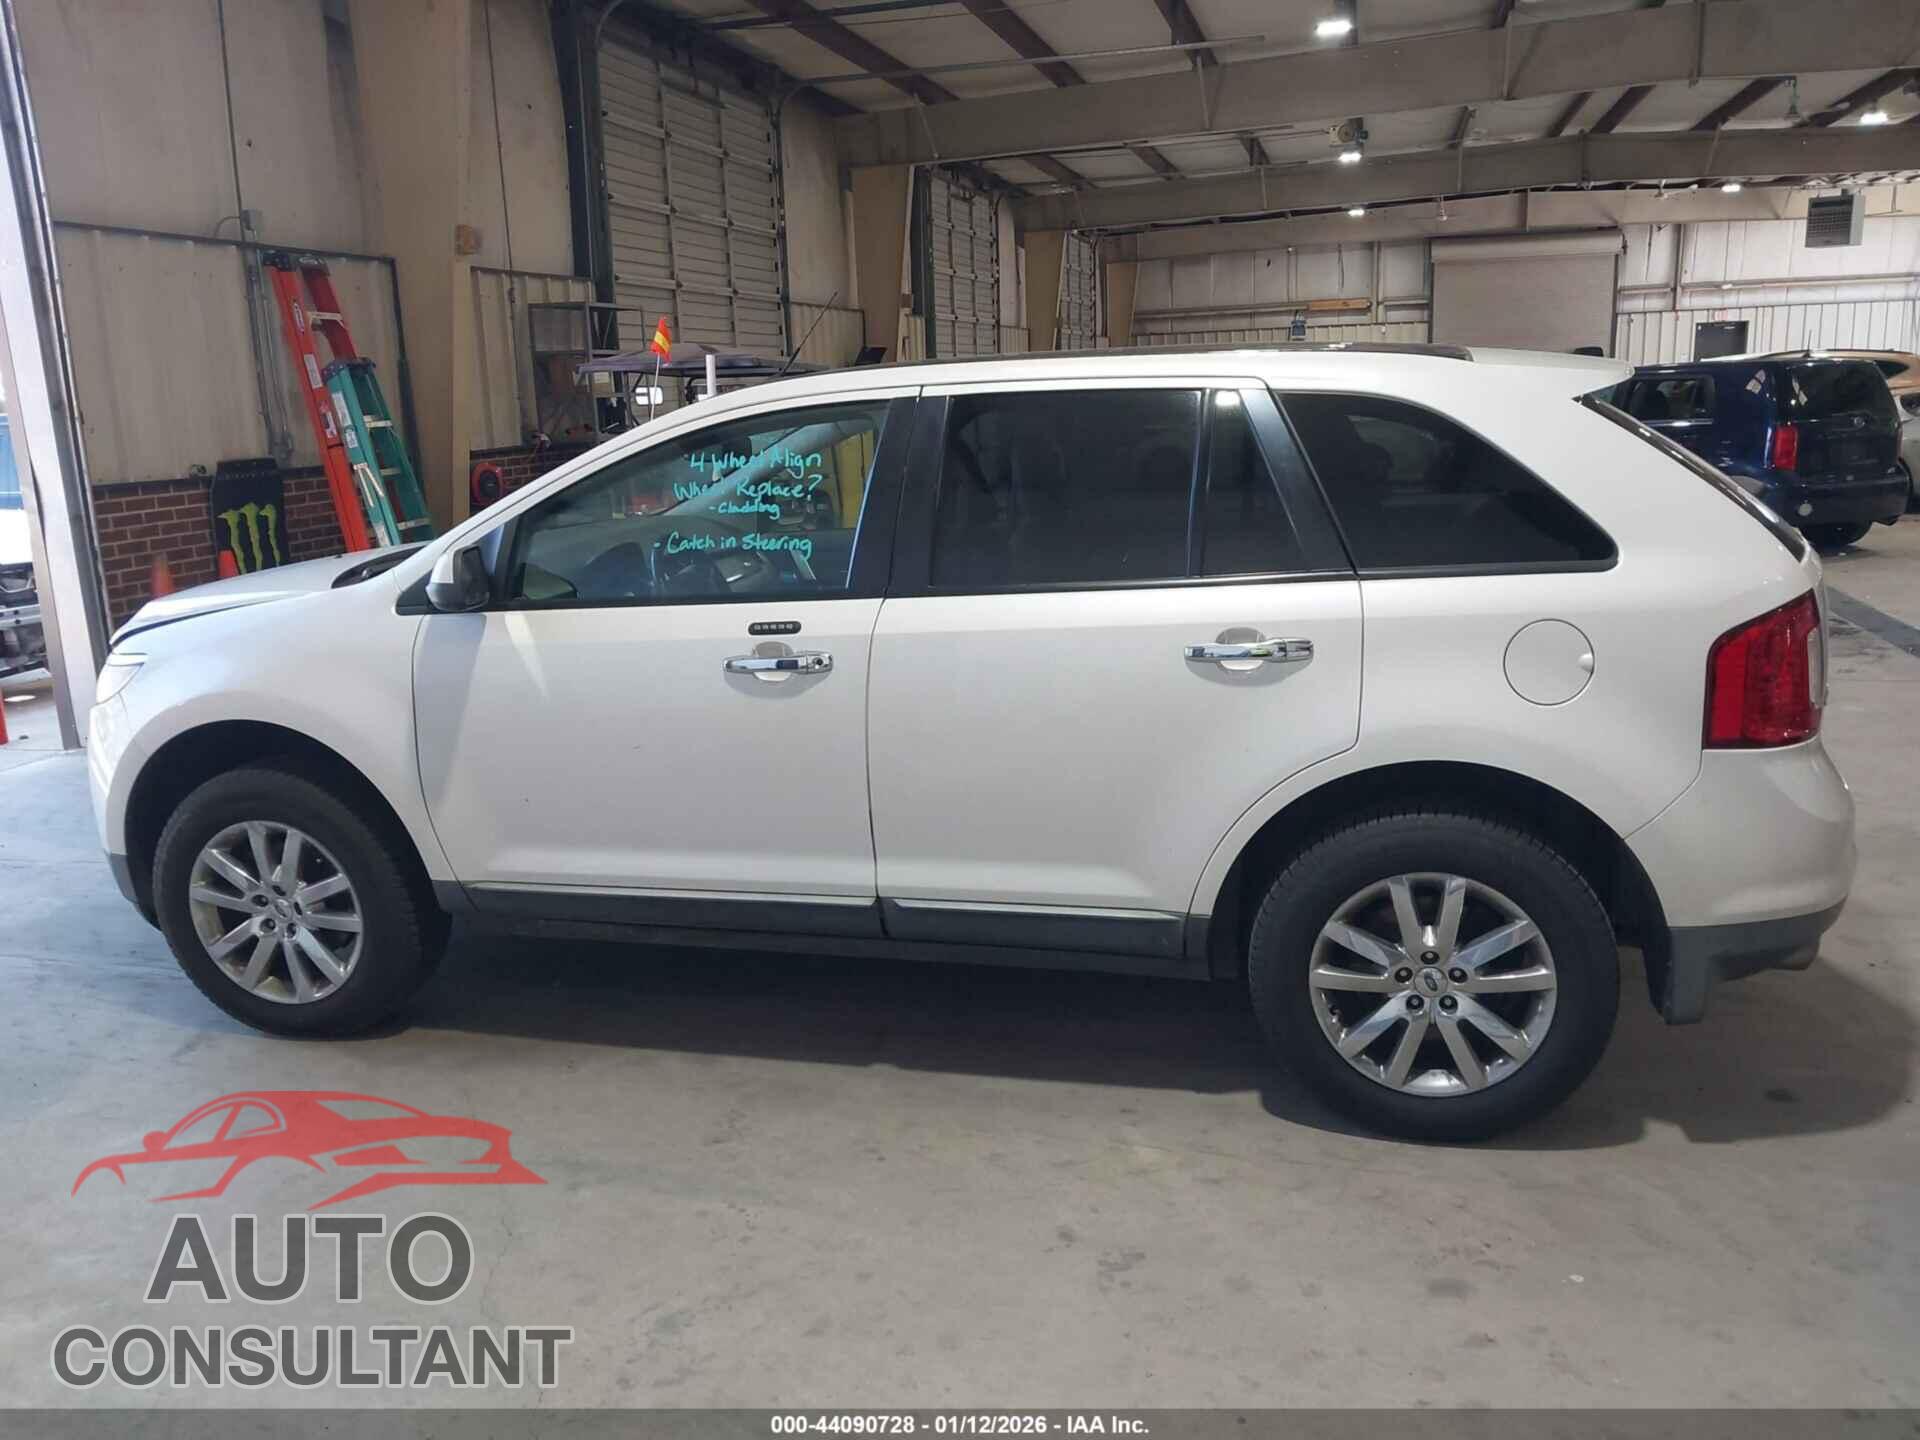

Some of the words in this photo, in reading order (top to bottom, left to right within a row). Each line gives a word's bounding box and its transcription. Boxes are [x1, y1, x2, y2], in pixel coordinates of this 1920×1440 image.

[689, 452, 705, 473] 4
[770, 447, 822, 479] Align
[736, 474, 823, 502] Replace?
[667, 531, 716, 554] Catch
[720, 535, 736, 549] in
